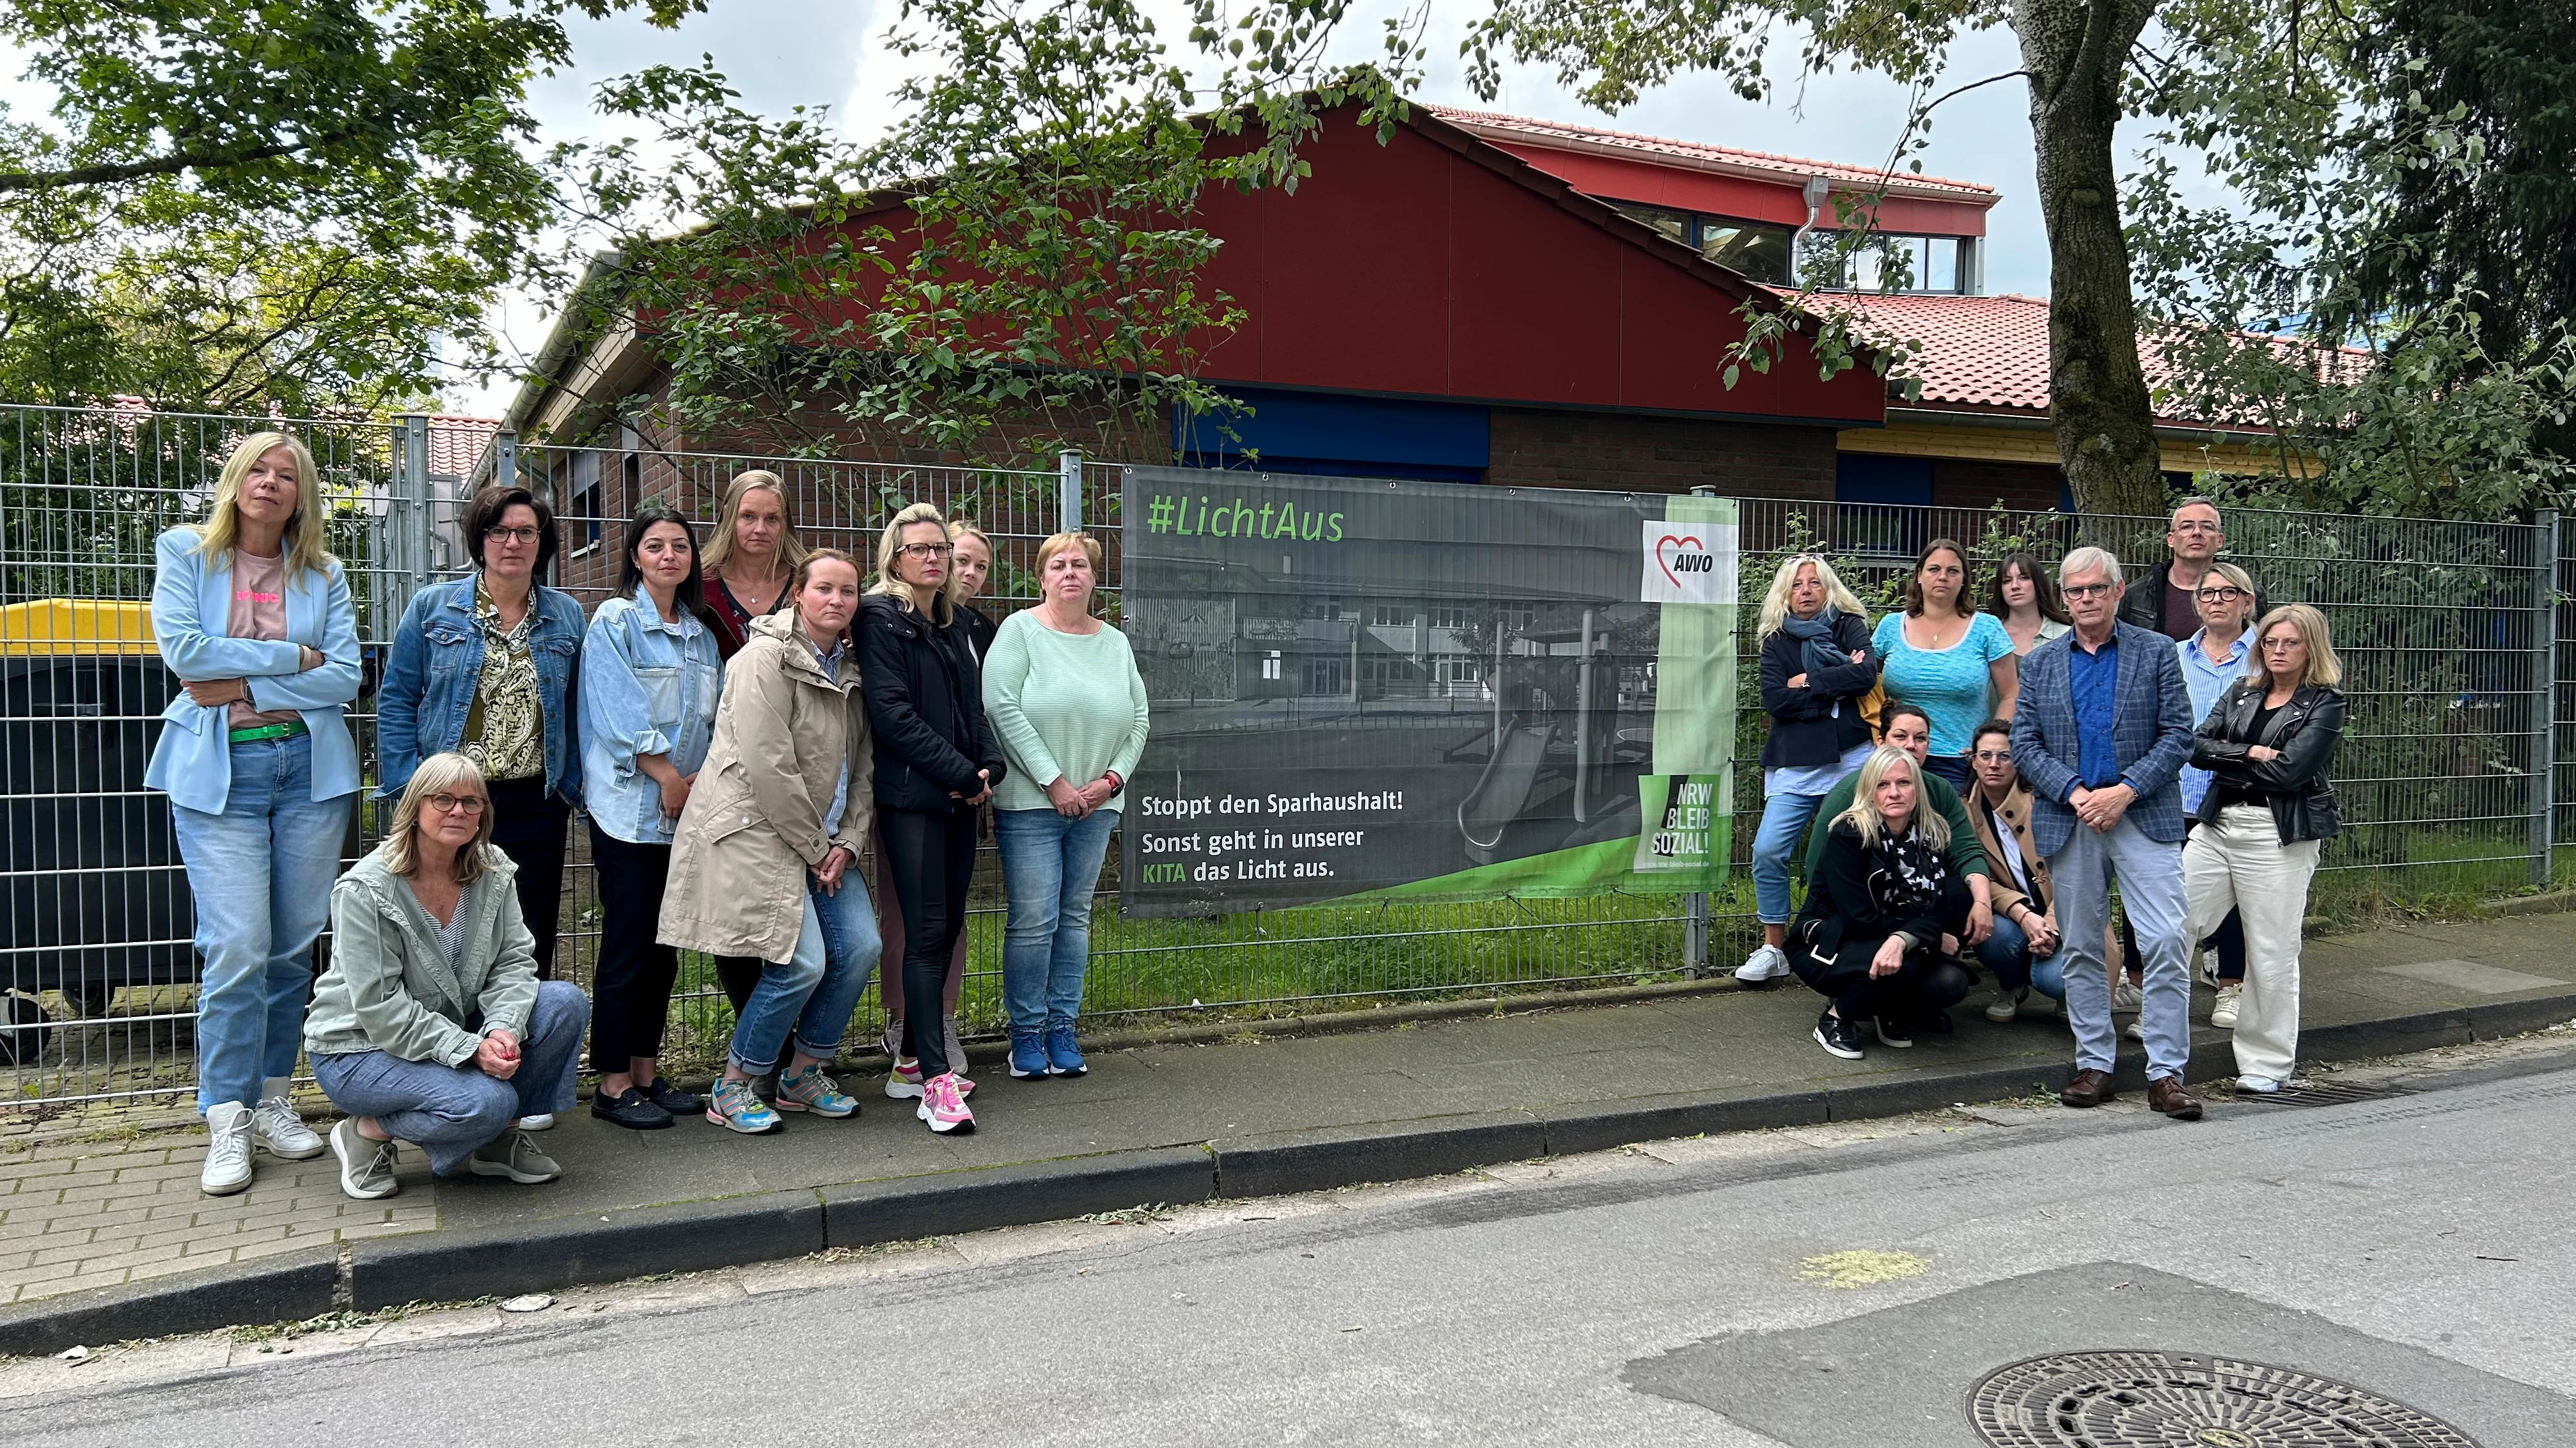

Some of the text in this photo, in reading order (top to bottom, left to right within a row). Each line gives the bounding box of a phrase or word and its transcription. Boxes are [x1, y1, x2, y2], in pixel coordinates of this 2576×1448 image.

[1147, 494, 1344, 542] #LichtAus
[1673, 554, 1713, 572] AWO
[1142, 791, 1403, 819] Stoppt den Sparhaushalt!
[1677, 783, 1712, 805] NRW
[1666, 807, 1709, 830] BLEIB
[1142, 829, 1364, 856] Sonst geht in unserer
[1651, 832, 1709, 854] SOZIAL!
[1142, 860, 1335, 883] KITA das Licht aus.
